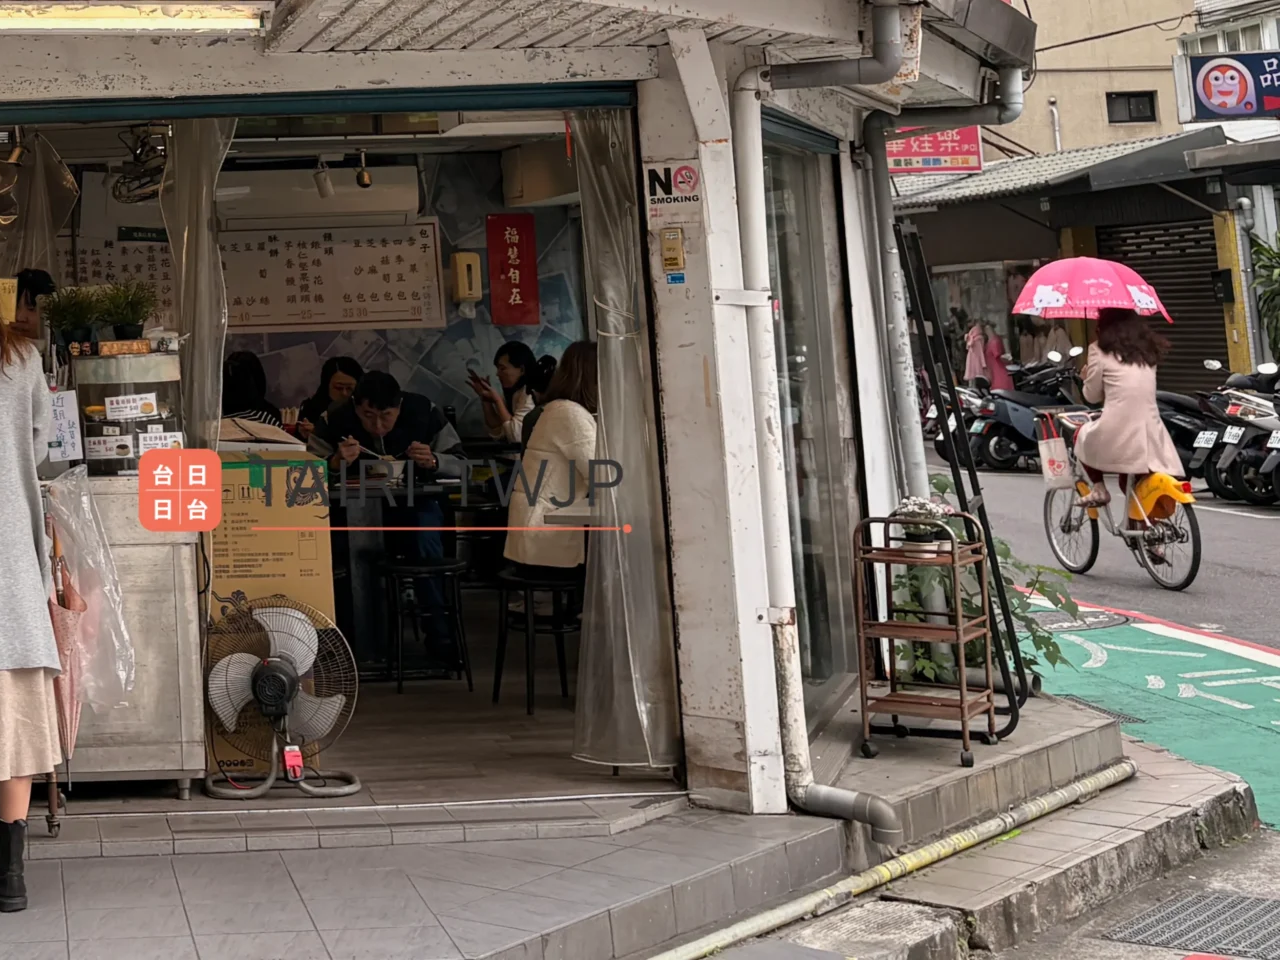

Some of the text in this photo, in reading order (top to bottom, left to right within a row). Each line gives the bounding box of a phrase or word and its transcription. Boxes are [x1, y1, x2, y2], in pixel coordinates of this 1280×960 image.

[650, 194, 700, 205] SMOKING
[419, 228, 431, 253] 包子
[504, 226, 523, 306] 福慧自在
